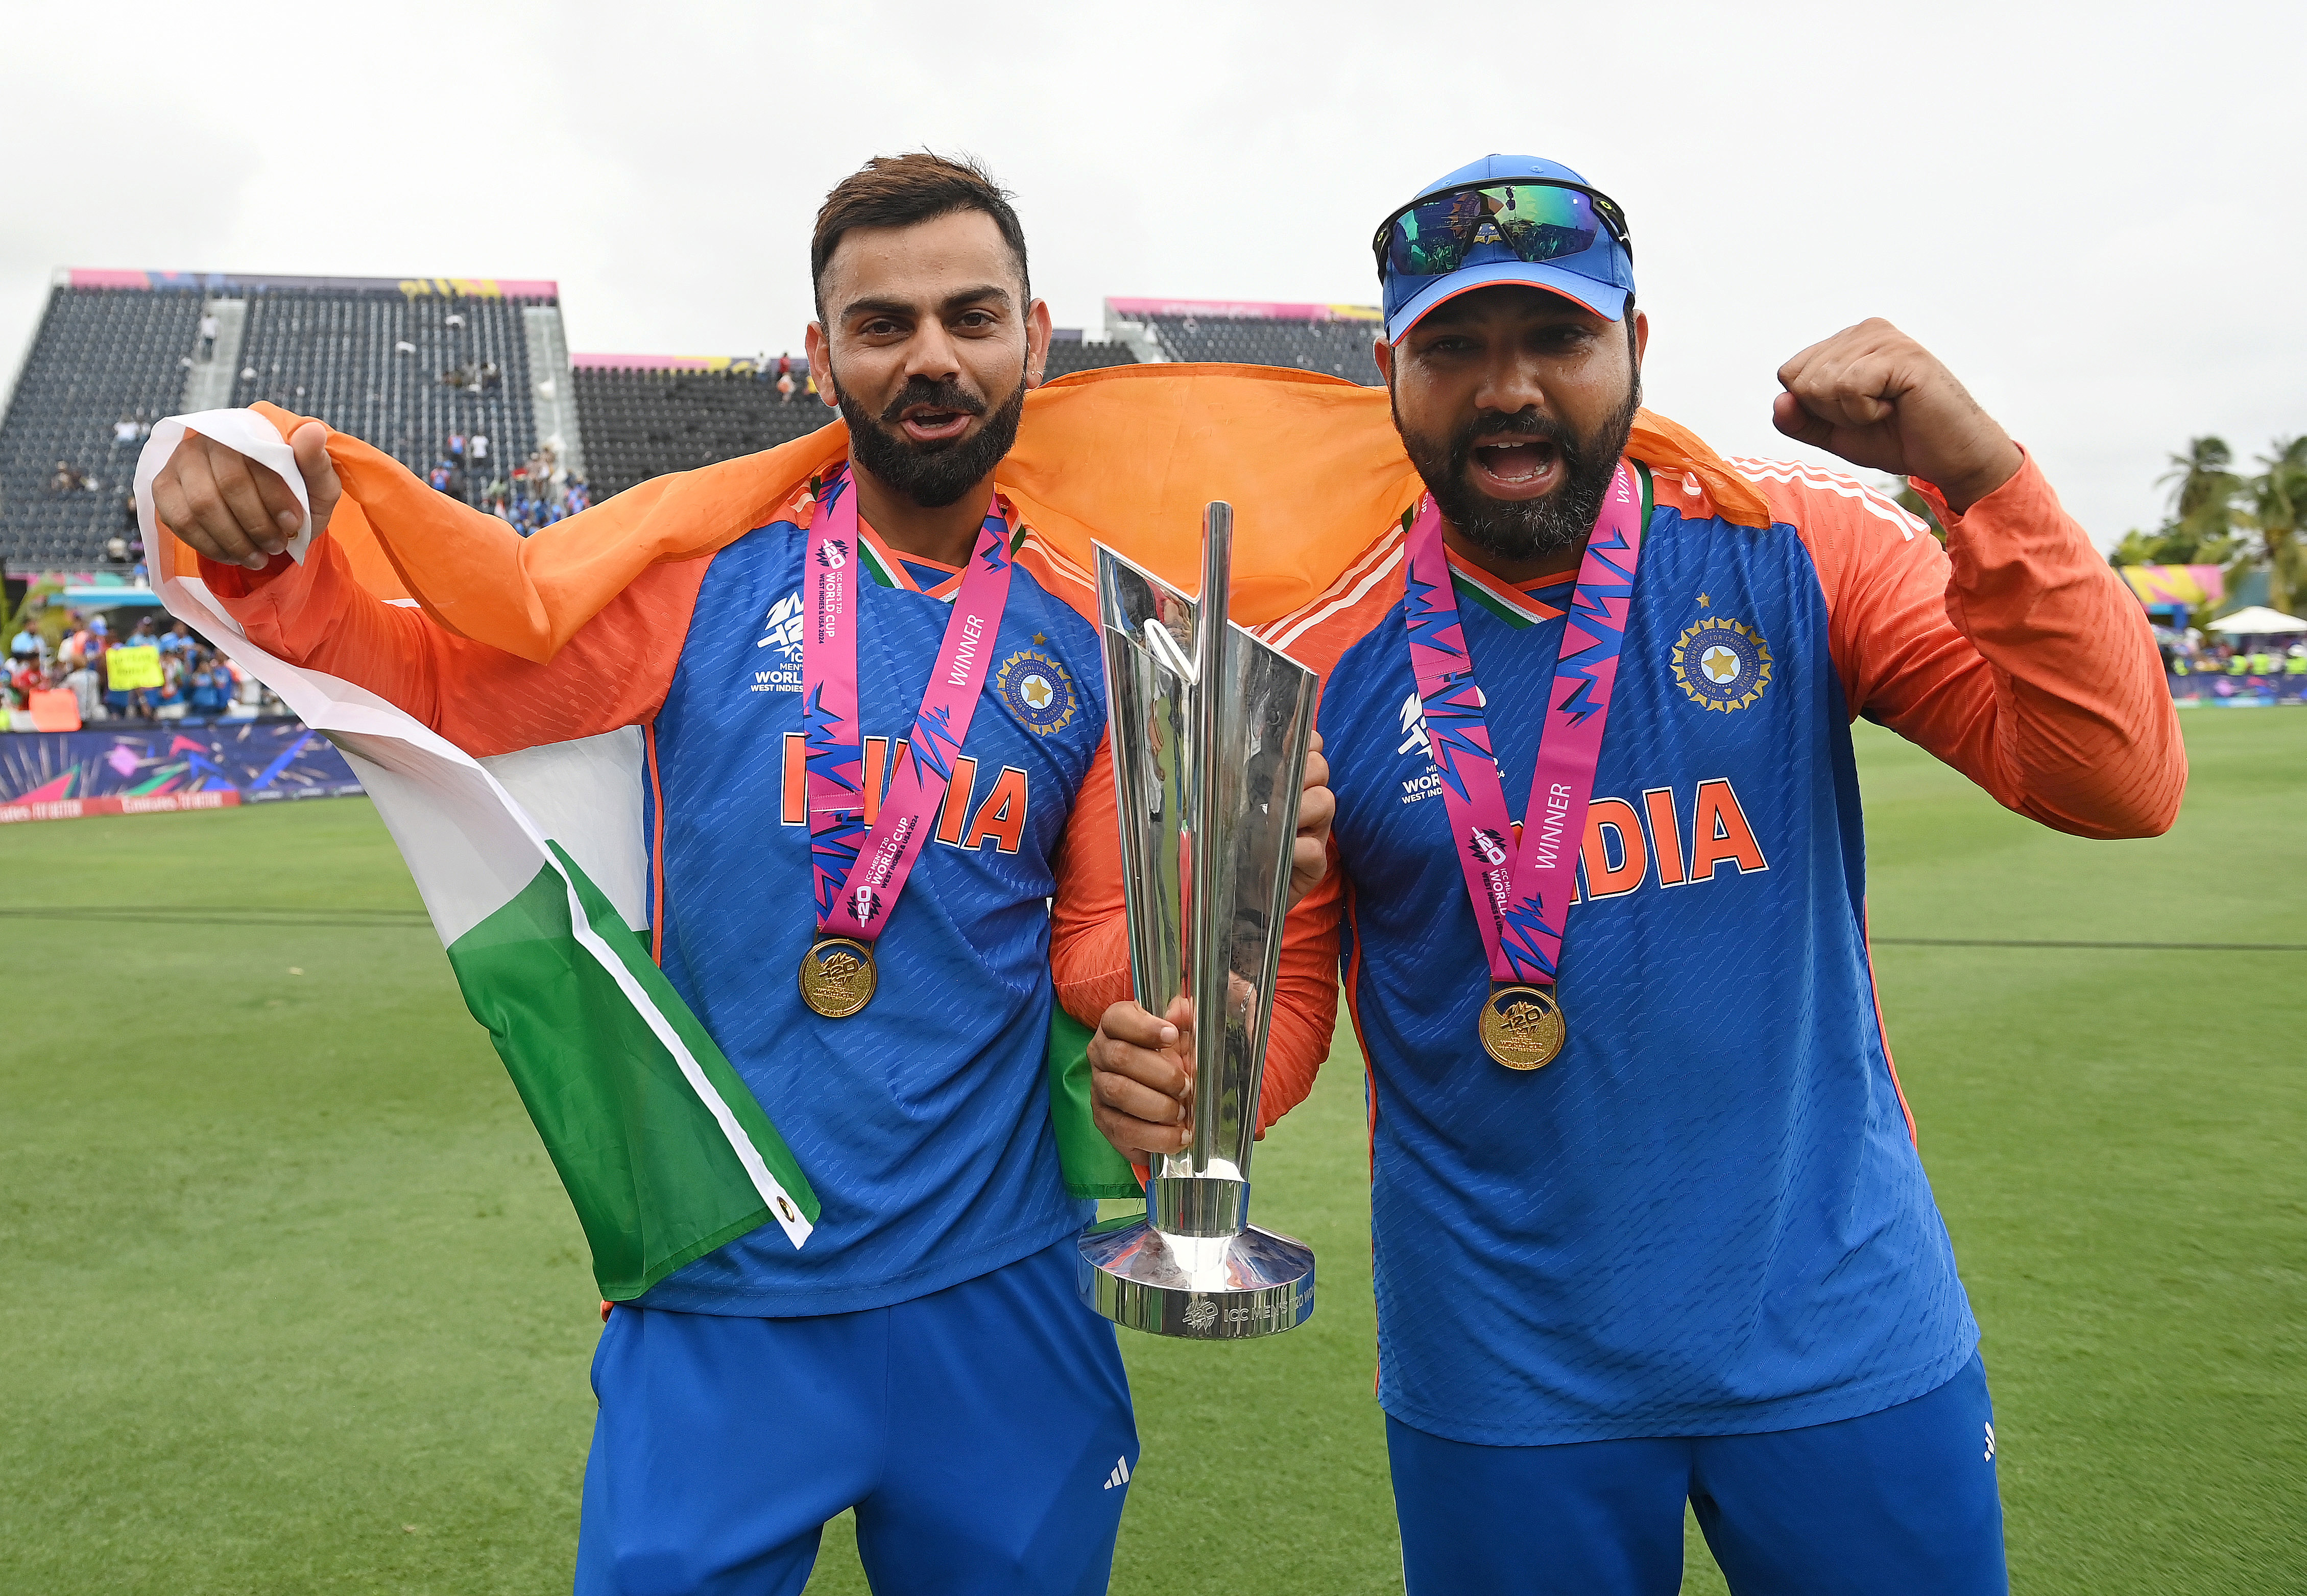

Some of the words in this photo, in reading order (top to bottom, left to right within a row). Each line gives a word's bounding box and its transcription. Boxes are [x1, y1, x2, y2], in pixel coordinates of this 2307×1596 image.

[823, 538, 846, 569] T20
[826, 572, 836, 612] WORLD
[757, 614, 804, 648] T2
[825, 615, 835, 637] CUP
[947, 614, 984, 686] WINNER
[1690, 638, 1709, 664] CONTROL
[1725, 636, 1750, 656] CRICKET
[791, 652, 803, 663] IC
[755, 671, 803, 684] WORL
[1013, 665, 1035, 681] CONTROL
[1738, 669, 1752, 687] INDIA
[751, 684, 775, 692] WEST
[776, 685, 804, 693] INDIES
[1696, 676, 1716, 693] BOARD
[1012, 692, 1025, 712] BOARD
[1402, 773, 1440, 793] WOR
[780, 732, 1029, 856] IIA
[1402, 791, 1425, 804] WEST
[1427, 787, 1443, 798] IND
[1534, 783, 1572, 868] WINNER
[871, 843, 897, 884] WORLD
[893, 817, 909, 841] CUP
[881, 870, 893, 888] WEST
[892, 850, 903, 870] INDIES
[903, 831, 912, 843] USA
[908, 814, 919, 831] 2024
[1471, 826, 1506, 866] T20
[864, 869, 874, 882] ICC
[871, 850, 883, 870] MEN'S
[880, 837, 890, 852] T20
[1481, 871, 1492, 890] WEST
[1500, 868, 1509, 880] ICC
[856, 886, 872, 928] T20
[1223, 1308, 1249, 1322] ICC
